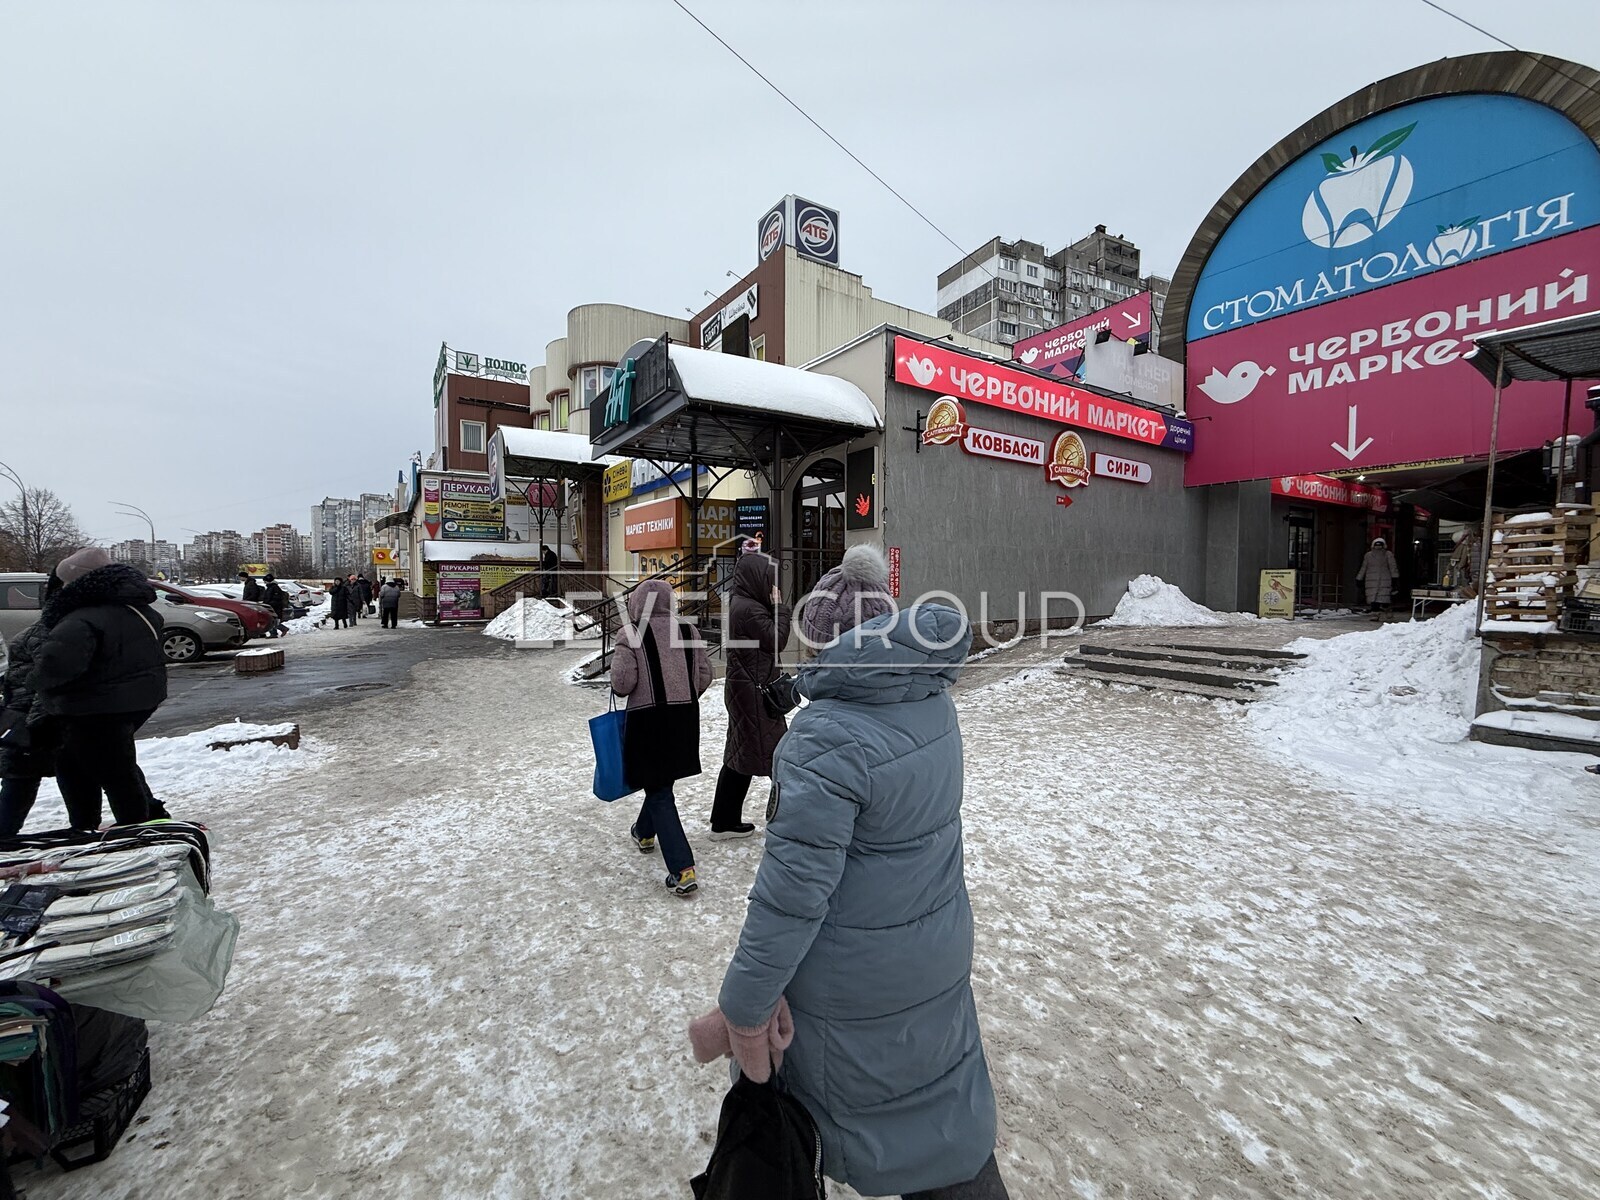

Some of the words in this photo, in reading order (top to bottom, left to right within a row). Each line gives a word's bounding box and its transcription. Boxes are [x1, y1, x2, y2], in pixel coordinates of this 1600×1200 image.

[763, 225, 779, 248] АТБ
[802, 223, 828, 240] АТБ
[1289, 268, 1588, 364] ЧЕРВОНИЙ
[1045, 317, 1110, 349] ЧЕРВОИЙ
[1044, 338, 1086, 360] МАРКЕ
[485, 357, 527, 374] ПОЛЮС
[950, 366, 1079, 420] ЧЕРВОНИЙ
[1087, 404, 1160, 440] МАРКЕТ
[972, 432, 1039, 459] КОВБАСИ
[1107, 459, 1139, 477] СИРИ
[443, 483, 491, 494] ПЕРУКАР
[625, 522, 646, 536] МАРКЕТ
[646, 517, 674, 533] ТЕХНІКИ
